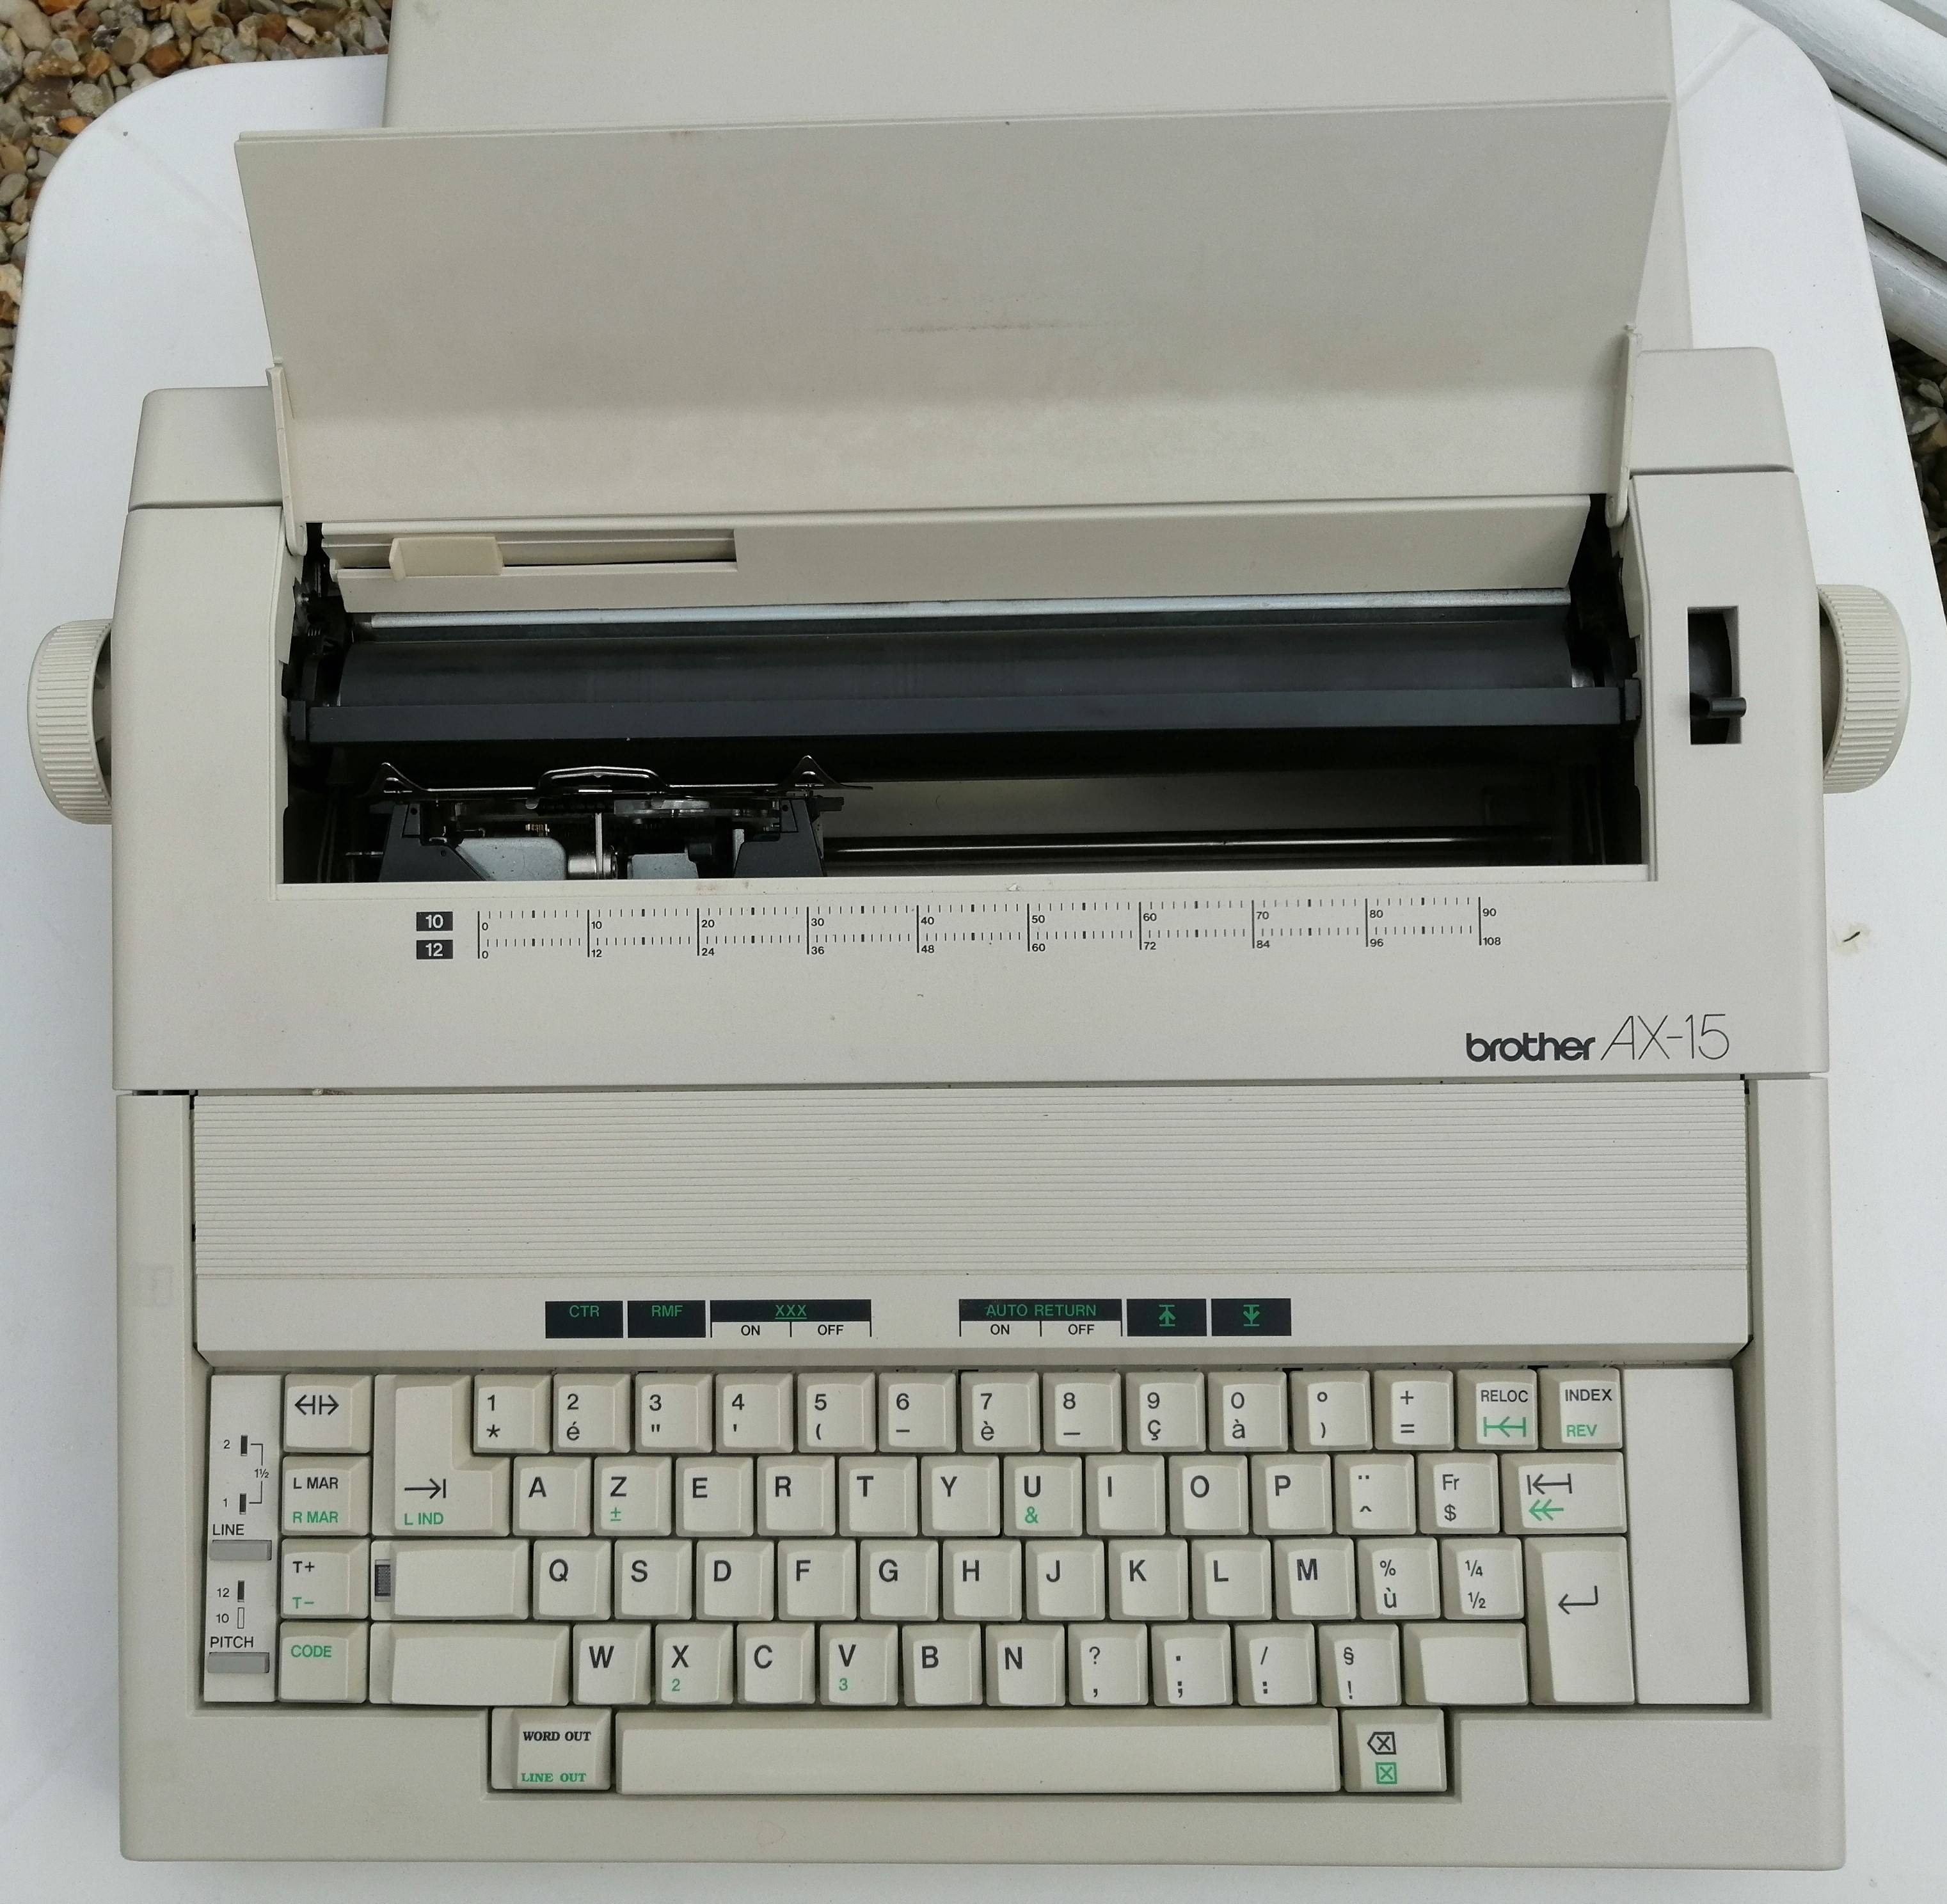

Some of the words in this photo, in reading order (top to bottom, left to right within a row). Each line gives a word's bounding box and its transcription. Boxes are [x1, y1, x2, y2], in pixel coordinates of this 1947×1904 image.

[425, 914, 444, 929] 10
[481, 922, 489, 931] 0
[591, 921, 602, 930] 10
[701, 919, 715, 928] 20
[811, 917, 825, 926] 30
[920, 916, 935, 925] 40
[1031, 914, 1045, 924] 50
[1143, 912, 1157, 922] 60
[1256, 911, 1269, 920] 70
[1369, 909, 1383, 919] 80
[1482, 908, 1497, 917] 90
[425, 942, 443, 957] 12
[481, 950, 489, 959] 0
[591, 949, 602, 958] 12
[701, 948, 715, 956] 24
[811, 946, 825, 955] 36
[921, 944, 935, 954] 48
[1031, 943, 1045, 952] 60
[1143, 941, 1156, 950] 72
[1256, 940, 1270, 949] 84
[1370, 938, 1384, 948] 96
[1482, 937, 1501, 946] 108
[1466, 1032, 1596, 1063] brother
[1600, 1013, 1729, 1061] AX-15
[569, 1305, 600, 1318] CTR
[651, 1305, 683, 1317] RMF
[774, 1304, 807, 1320] XXX
[985, 1303, 1028, 1318] AUTO
[1034, 1304, 1097, 1317] RETURN
[740, 1324, 760, 1337] ON
[817, 1324, 844, 1336] OFF
[990, 1324, 1010, 1335] ON
[1068, 1324, 1095, 1335] OFF
[487, 1394, 495, 1411] 1
[567, 1393, 579, 1410] 2
[649, 1394, 662, 1411] 3
[731, 1393, 745, 1411] 4
[814, 1393, 827, 1411] 5
[896, 1393, 910, 1411] 6
[980, 1393, 992, 1410] 7
[1063, 1392, 1076, 1410] 8
[1147, 1392, 1160, 1409] 9
[1481, 1390, 1529, 1403] RELOC
[1565, 1388, 1612, 1402] INDEX
[566, 1421, 580, 1441] é
[981, 1420, 994, 1441] è
[1232, 1418, 1246, 1439] à
[1566, 1424, 1598, 1438] REV
[223, 1439, 230, 1449] 2
[293, 1477, 302, 1489] L
[306, 1477, 338, 1489] MAR
[528, 1477, 546, 1498] A
[610, 1476, 627, 1497] Z
[692, 1477, 708, 1498] E
[775, 1476, 791, 1498] R
[856, 1475, 874, 1497] T
[940, 1476, 958, 1497] Y
[1024, 1475, 1041, 1498] U
[1107, 1476, 1112, 1497] I
[1190, 1475, 1210, 1498] O
[1275, 1475, 1291, 1496] P
[1442, 1473, 1459, 1491] Fr
[223, 1498, 227, 1507] 1
[292, 1511, 303, 1524] R
[307, 1511, 338, 1523] MAR
[404, 1512, 414, 1526] L
[418, 1512, 444, 1526] IND
[1024, 1506, 1039, 1524] &
[1444, 1503, 1457, 1522] $
[212, 1523, 244, 1535] LINE
[292, 1560, 315, 1573] T+
[549, 1559, 569, 1582] Q
[631, 1560, 648, 1583] S
[713, 1560, 732, 1582] D
[796, 1559, 811, 1582] F
[878, 1559, 898, 1583] G
[962, 1560, 980, 1582] H
[1045, 1560, 1060, 1583] J
[1129, 1559, 1147, 1582] K
[1213, 1560, 1229, 1582] L
[1296, 1558, 1318, 1581] M
[1379, 1559, 1396, 1577] %
[217, 1587, 230, 1598] 12
[1383, 1587, 1397, 1608] ù
[216, 1613, 230, 1623] 10
[210, 1635, 254, 1649] PITCH
[290, 1644, 332, 1658] CODE
[589, 1646, 615, 1669] W
[671, 1645, 689, 1669] X
[754, 1644, 773, 1669] C
[838, 1644, 857, 1667] V
[921, 1646, 939, 1669] B
[1005, 1646, 1022, 1670] N
[1089, 1646, 1101, 1665] ?
[671, 1678, 680, 1692] 2
[839, 1678, 848, 1692] 3
[523, 1731, 560, 1741] WORD
[564, 1731, 592, 1741] OUT
[521, 1772, 553, 1782] LINE
[560, 1772, 587, 1782] OUT
